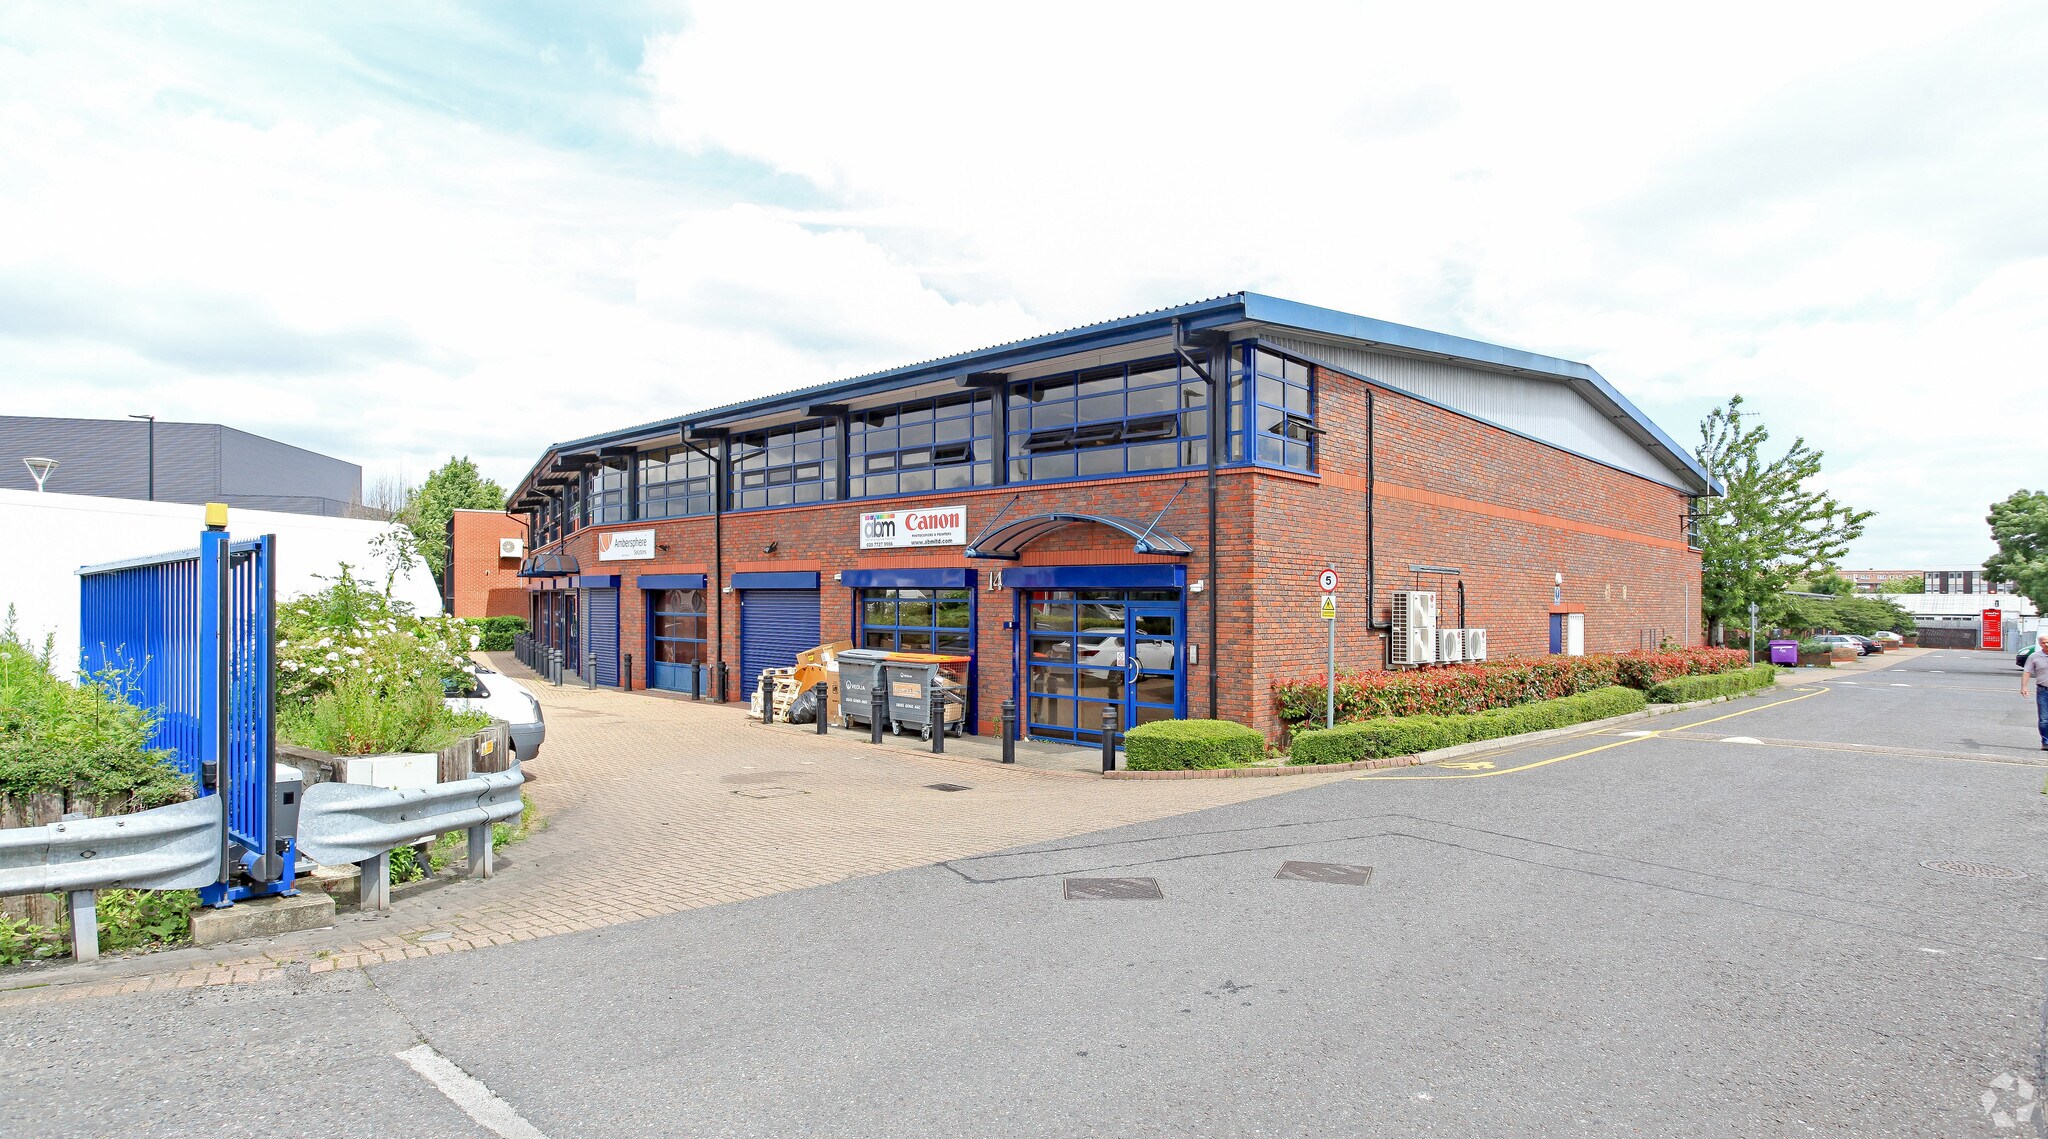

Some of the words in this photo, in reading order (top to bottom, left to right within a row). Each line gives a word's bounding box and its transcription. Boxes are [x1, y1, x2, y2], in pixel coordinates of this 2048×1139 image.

[865, 518, 895, 538] abm
[905, 513, 959, 530] Canon
[614, 537, 647, 548] Ambersphere
[988, 571, 1002, 591] 14
[1326, 576, 1332, 585] 5
